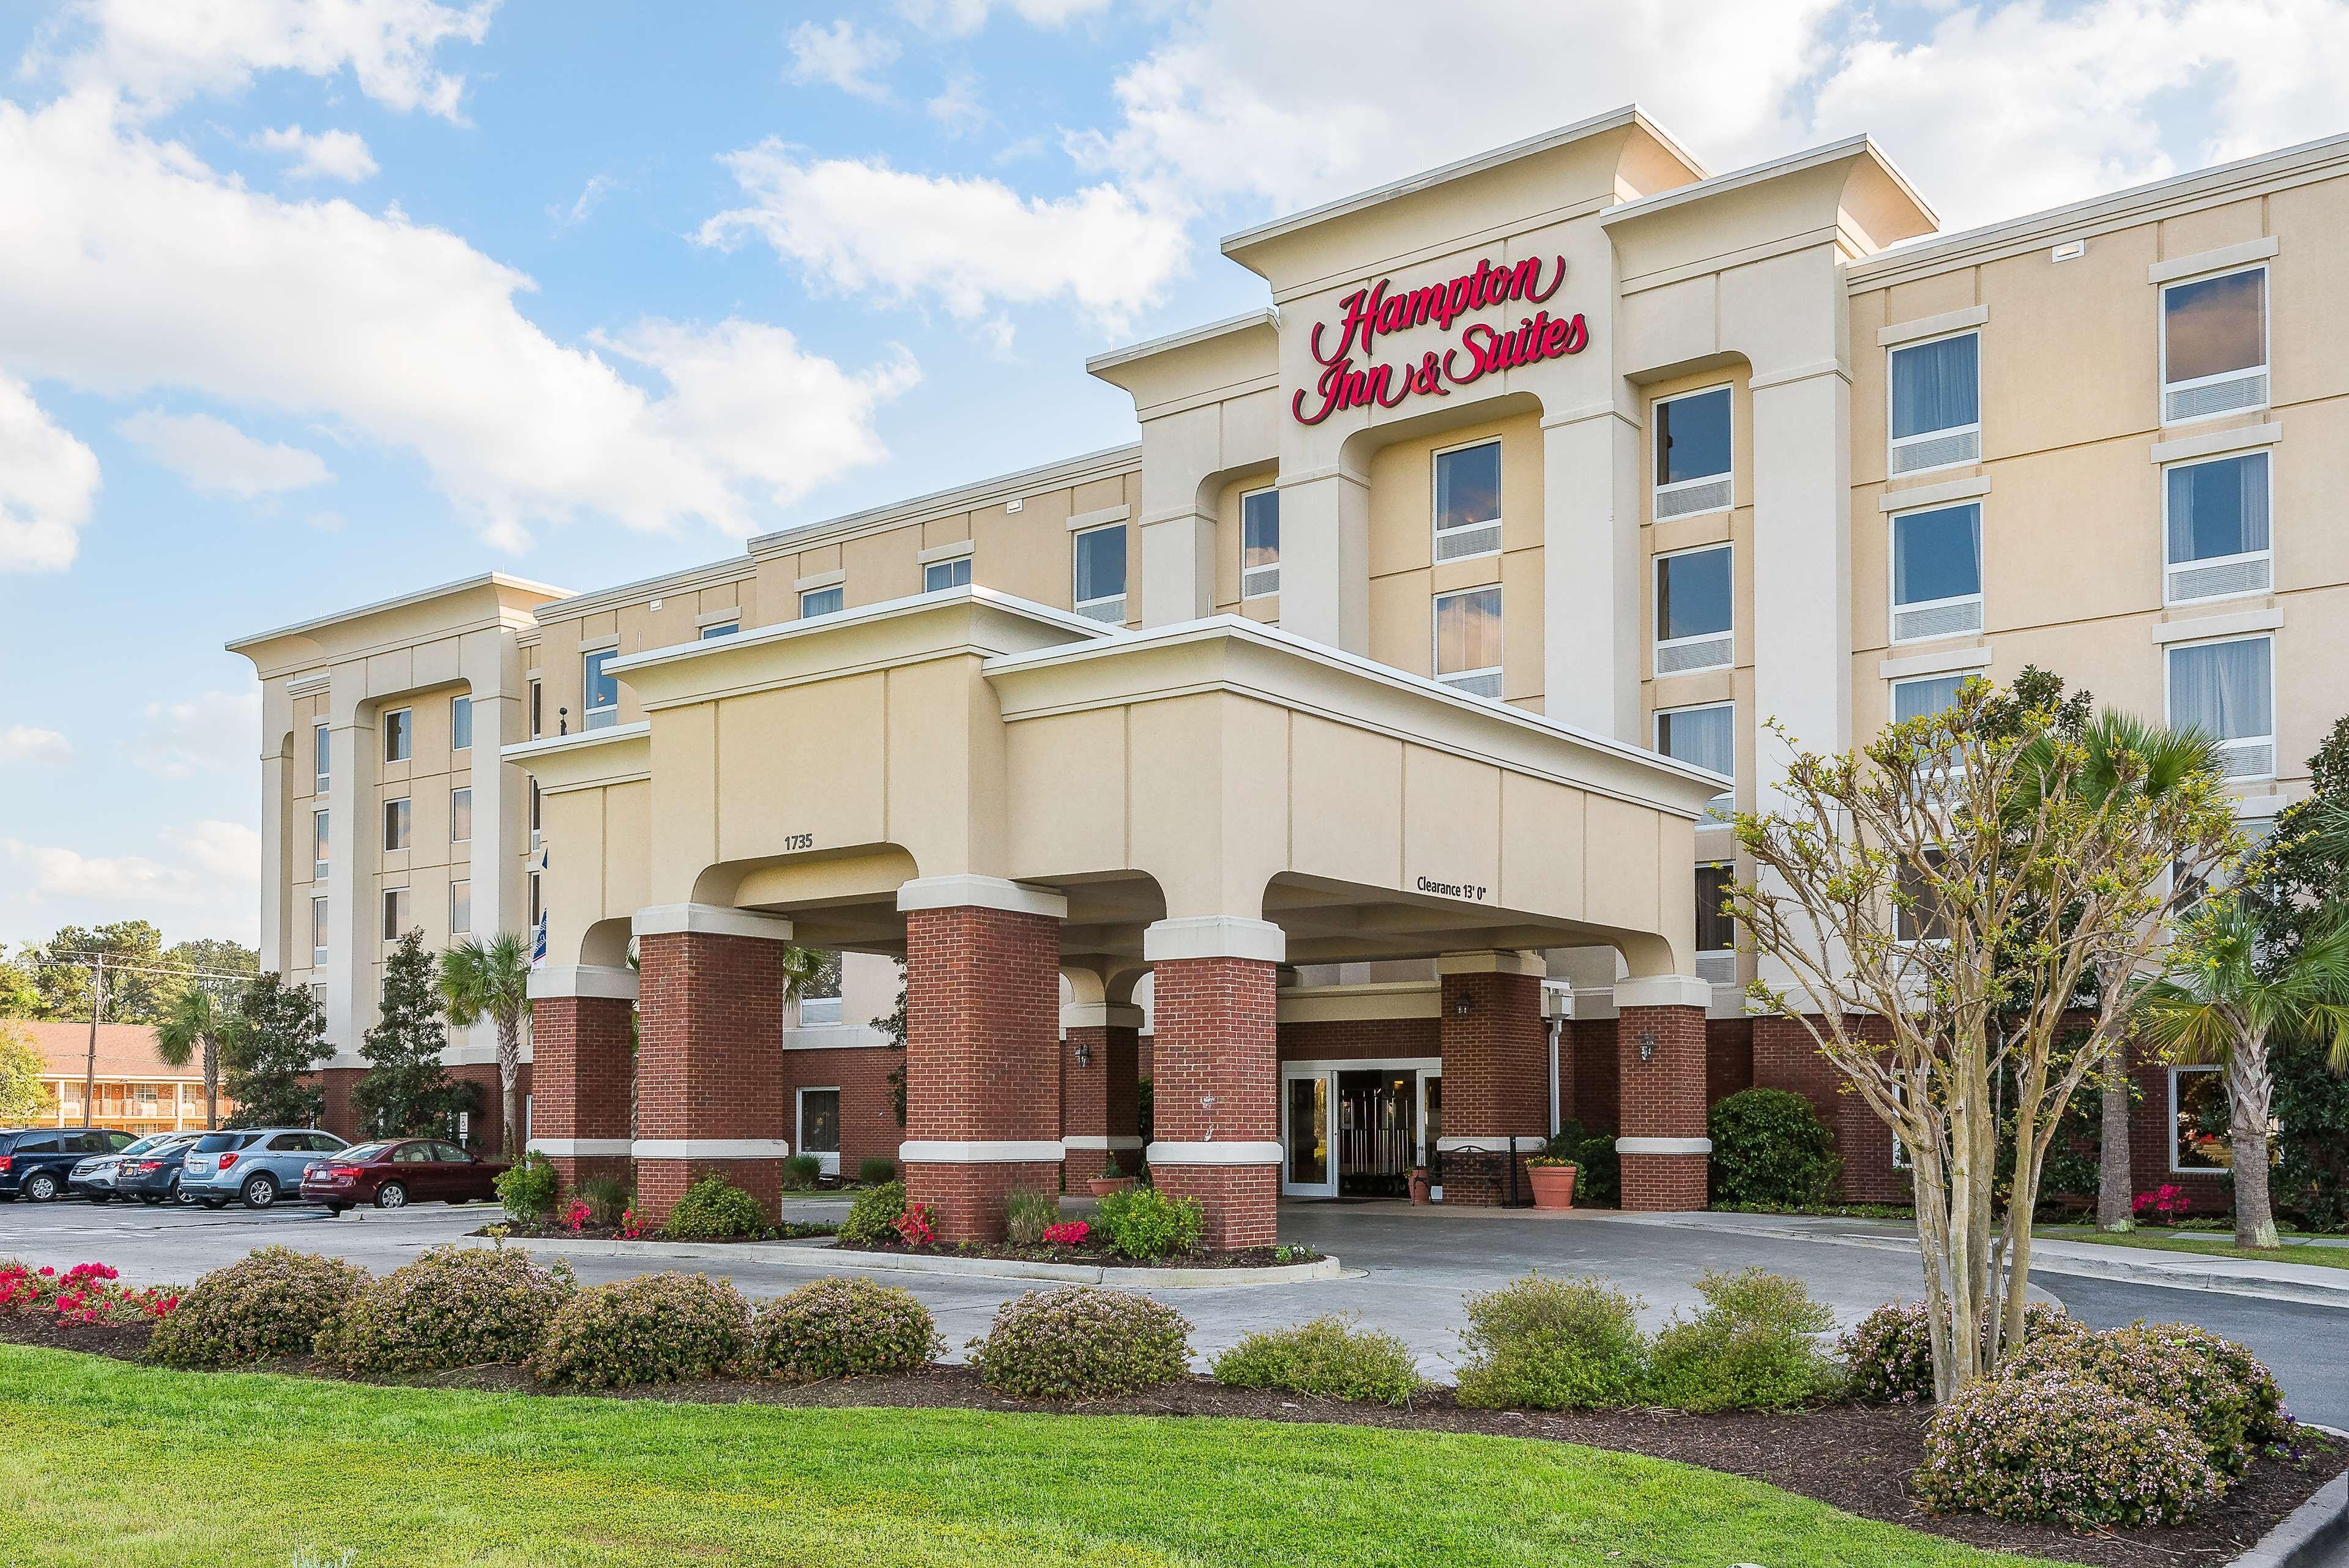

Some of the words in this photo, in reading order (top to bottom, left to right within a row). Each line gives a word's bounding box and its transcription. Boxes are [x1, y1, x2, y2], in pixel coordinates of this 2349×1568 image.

[1311, 255, 1566, 366] Hampton
[1292, 357, 1413, 425] Inn
[1410, 351, 1450, 396] &
[1443, 310, 1590, 384] Suites
[784, 833, 813, 850] 1735
[1417, 876, 1461, 896] Clearance
[1463, 884, 1475, 899] 13'
